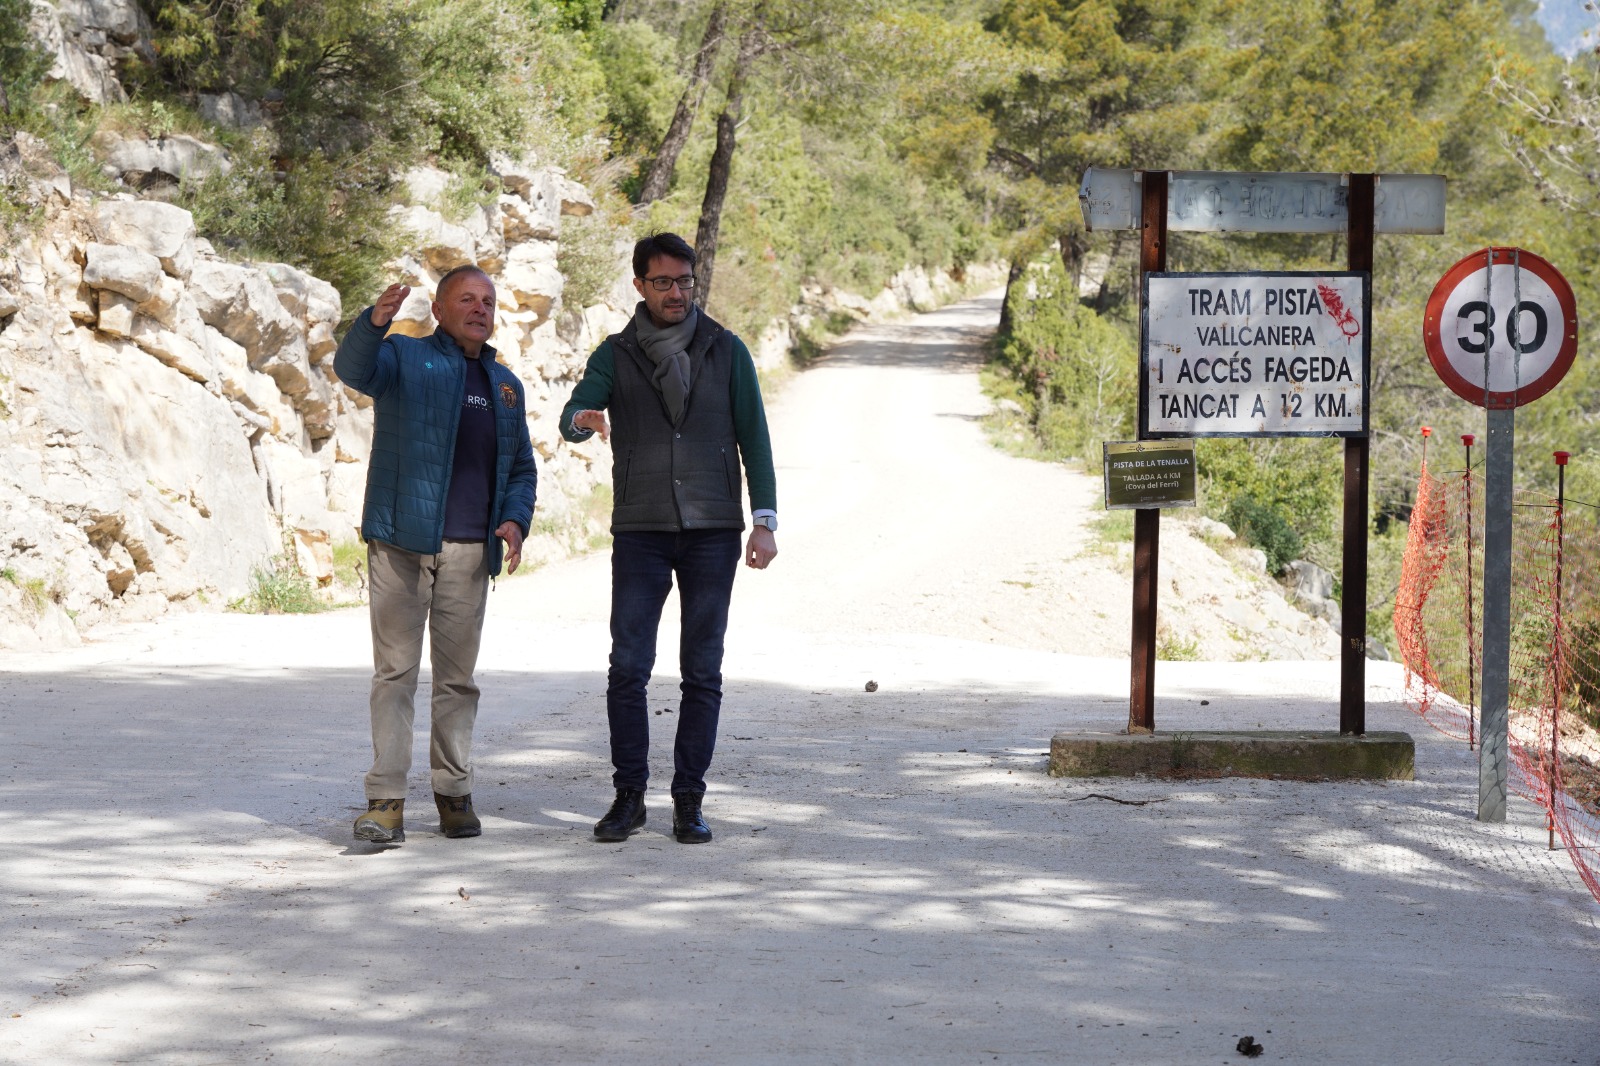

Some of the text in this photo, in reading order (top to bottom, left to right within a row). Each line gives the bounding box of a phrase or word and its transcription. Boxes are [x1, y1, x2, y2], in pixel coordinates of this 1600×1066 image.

[1188, 288, 1323, 316] TRAM PISTA
[1196, 326, 1316, 346] VALLCANERA
[1457, 300, 1548, 354] 30
[1158, 351, 1353, 384] I ACCÉS FAGEDA
[1159, 393, 1352, 418] TANCAT A 12 KM.
[1113, 461, 1134, 469] PISTA
[1157, 458, 1189, 466] TENALLA
[1123, 473, 1155, 482] TALLADA
[1125, 483, 1145, 491] (Cova
